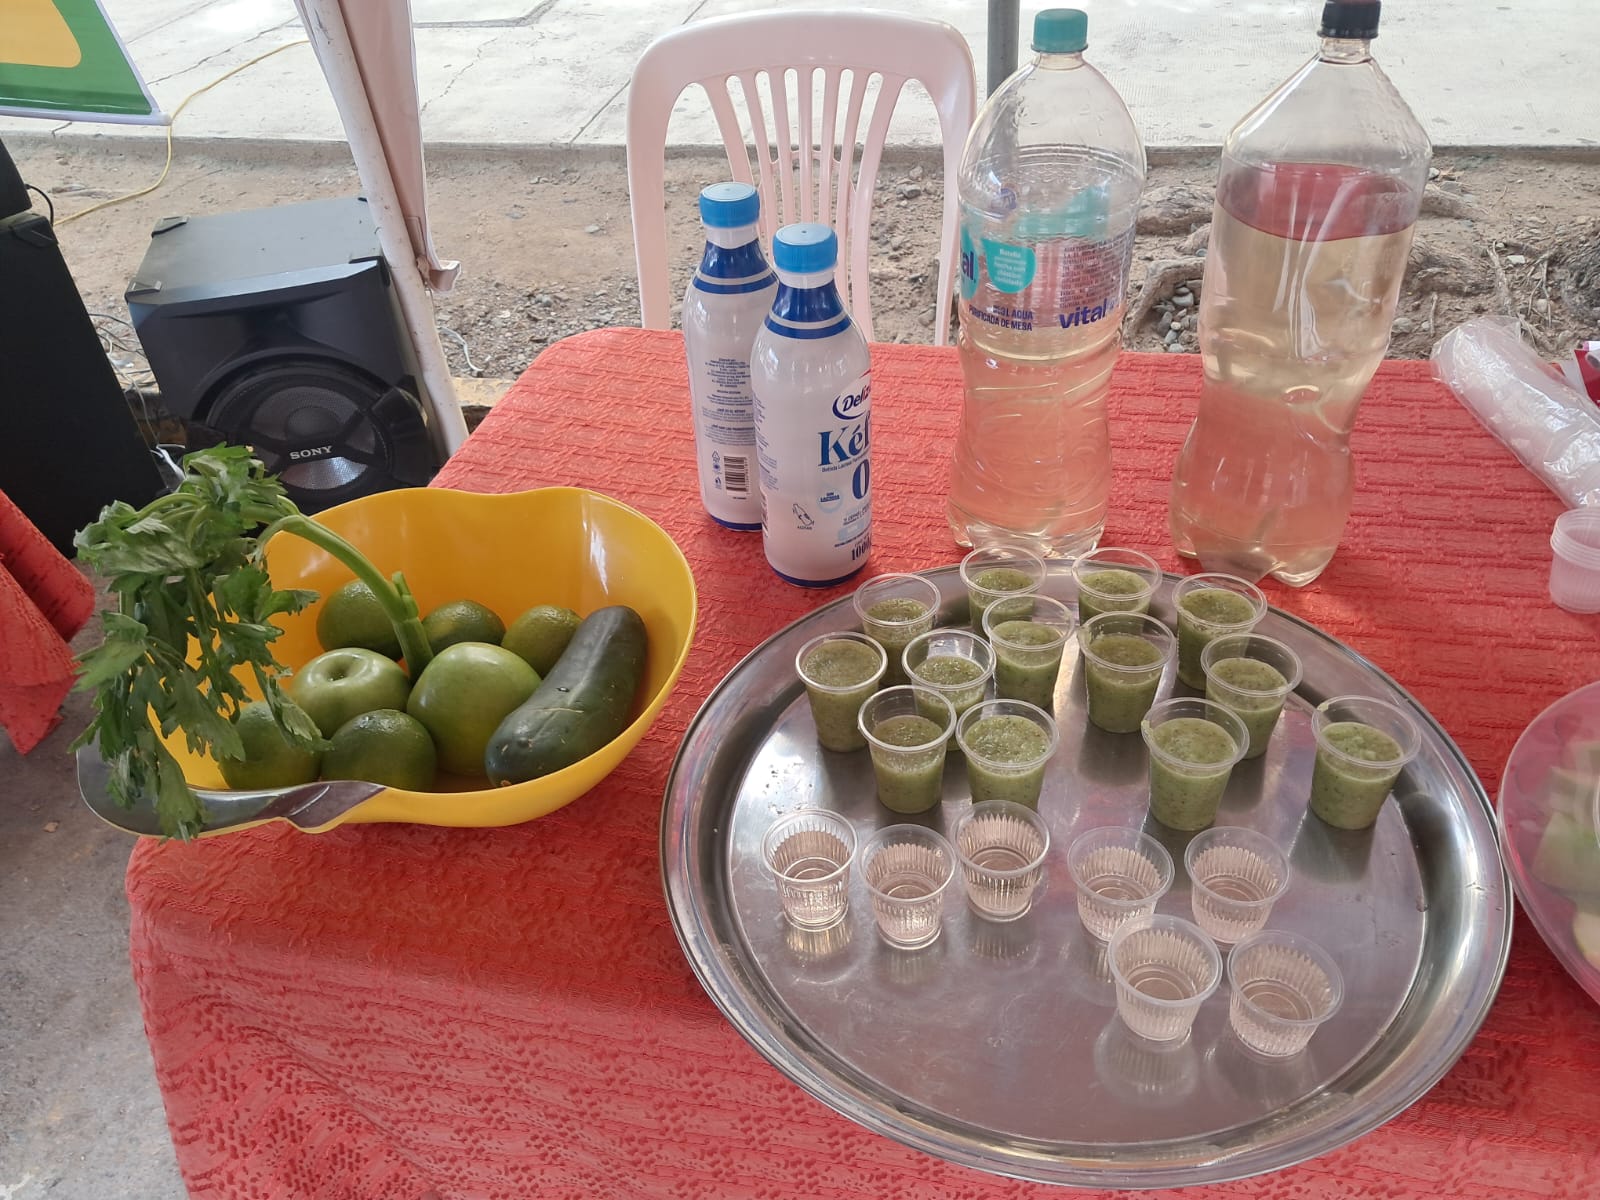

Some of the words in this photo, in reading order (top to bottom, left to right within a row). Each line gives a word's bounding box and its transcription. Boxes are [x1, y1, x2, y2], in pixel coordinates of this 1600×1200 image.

[1059, 298, 1107, 329] vital
[1000, 318, 1010, 328] DE
[1011, 321, 1033, 331] MESA
[289, 445, 332, 460] SONY
